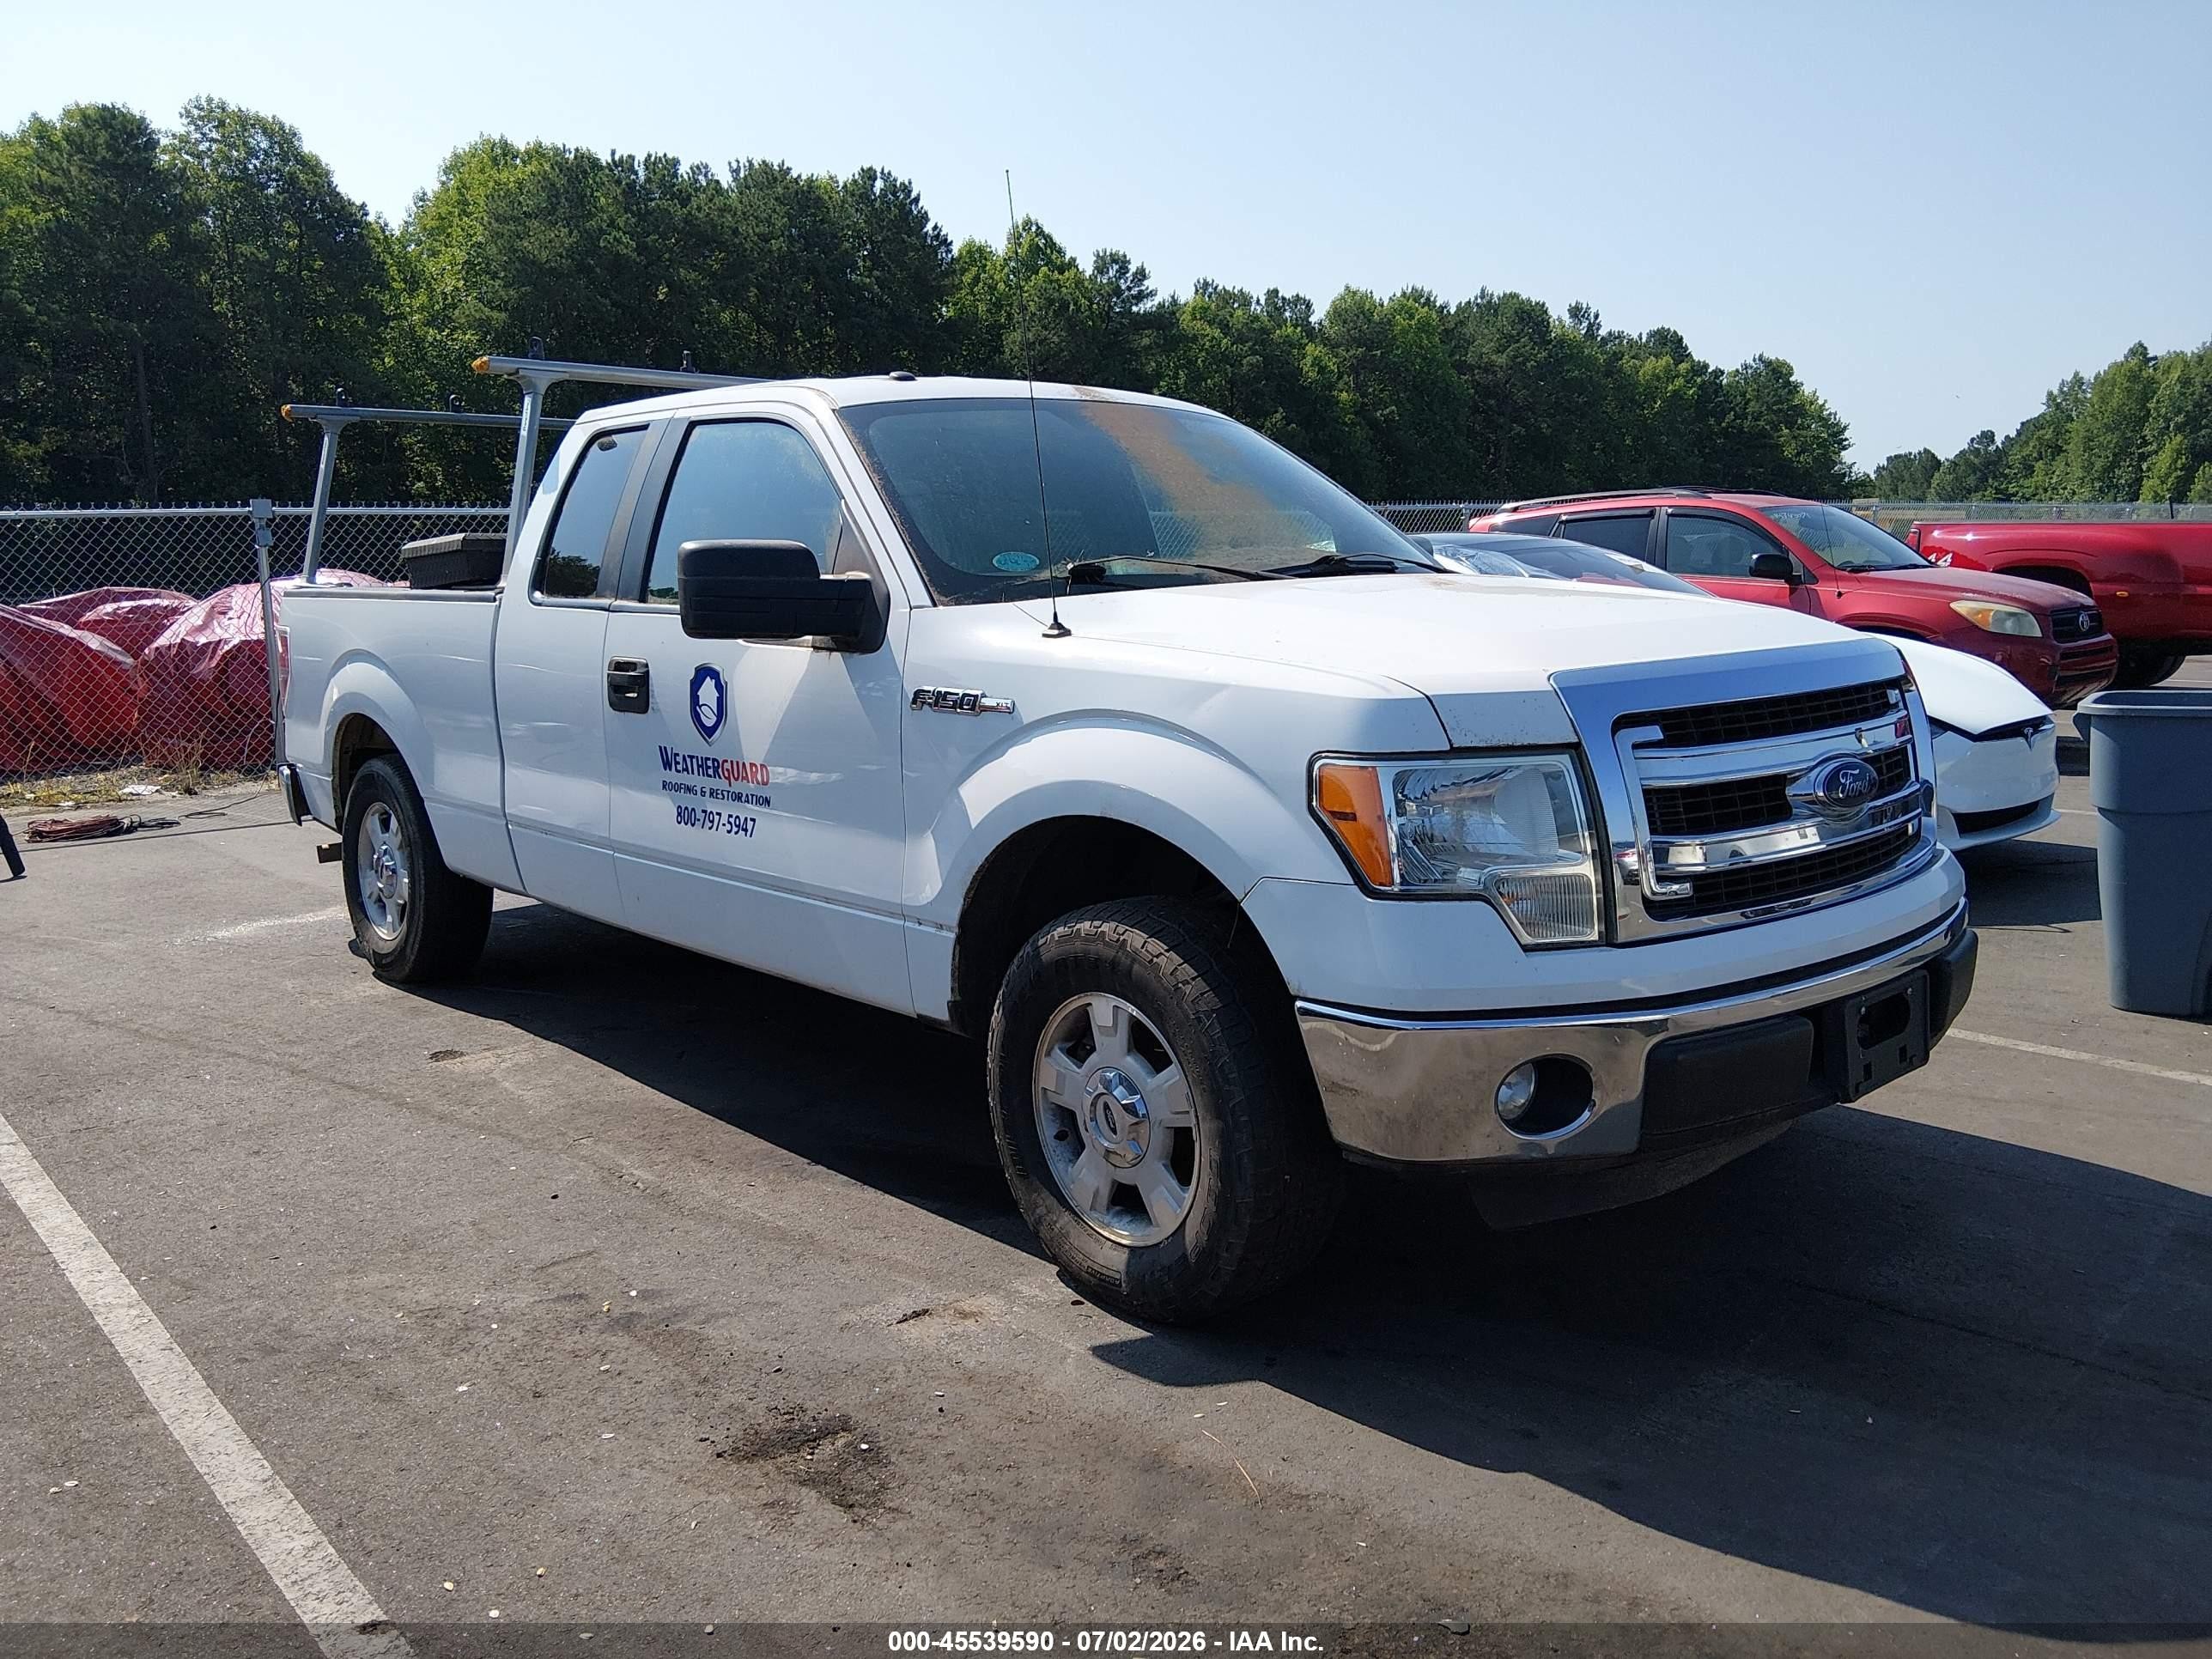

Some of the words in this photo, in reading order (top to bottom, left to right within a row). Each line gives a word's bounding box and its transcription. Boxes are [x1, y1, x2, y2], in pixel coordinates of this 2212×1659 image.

[662, 780, 698, 796] ROOFING
[700, 787, 707, 797] &
[708, 787, 771, 807] RESTORATION
[1838, 769, 1871, 798] Ford
[676, 806, 757, 838] 800-797-5947
